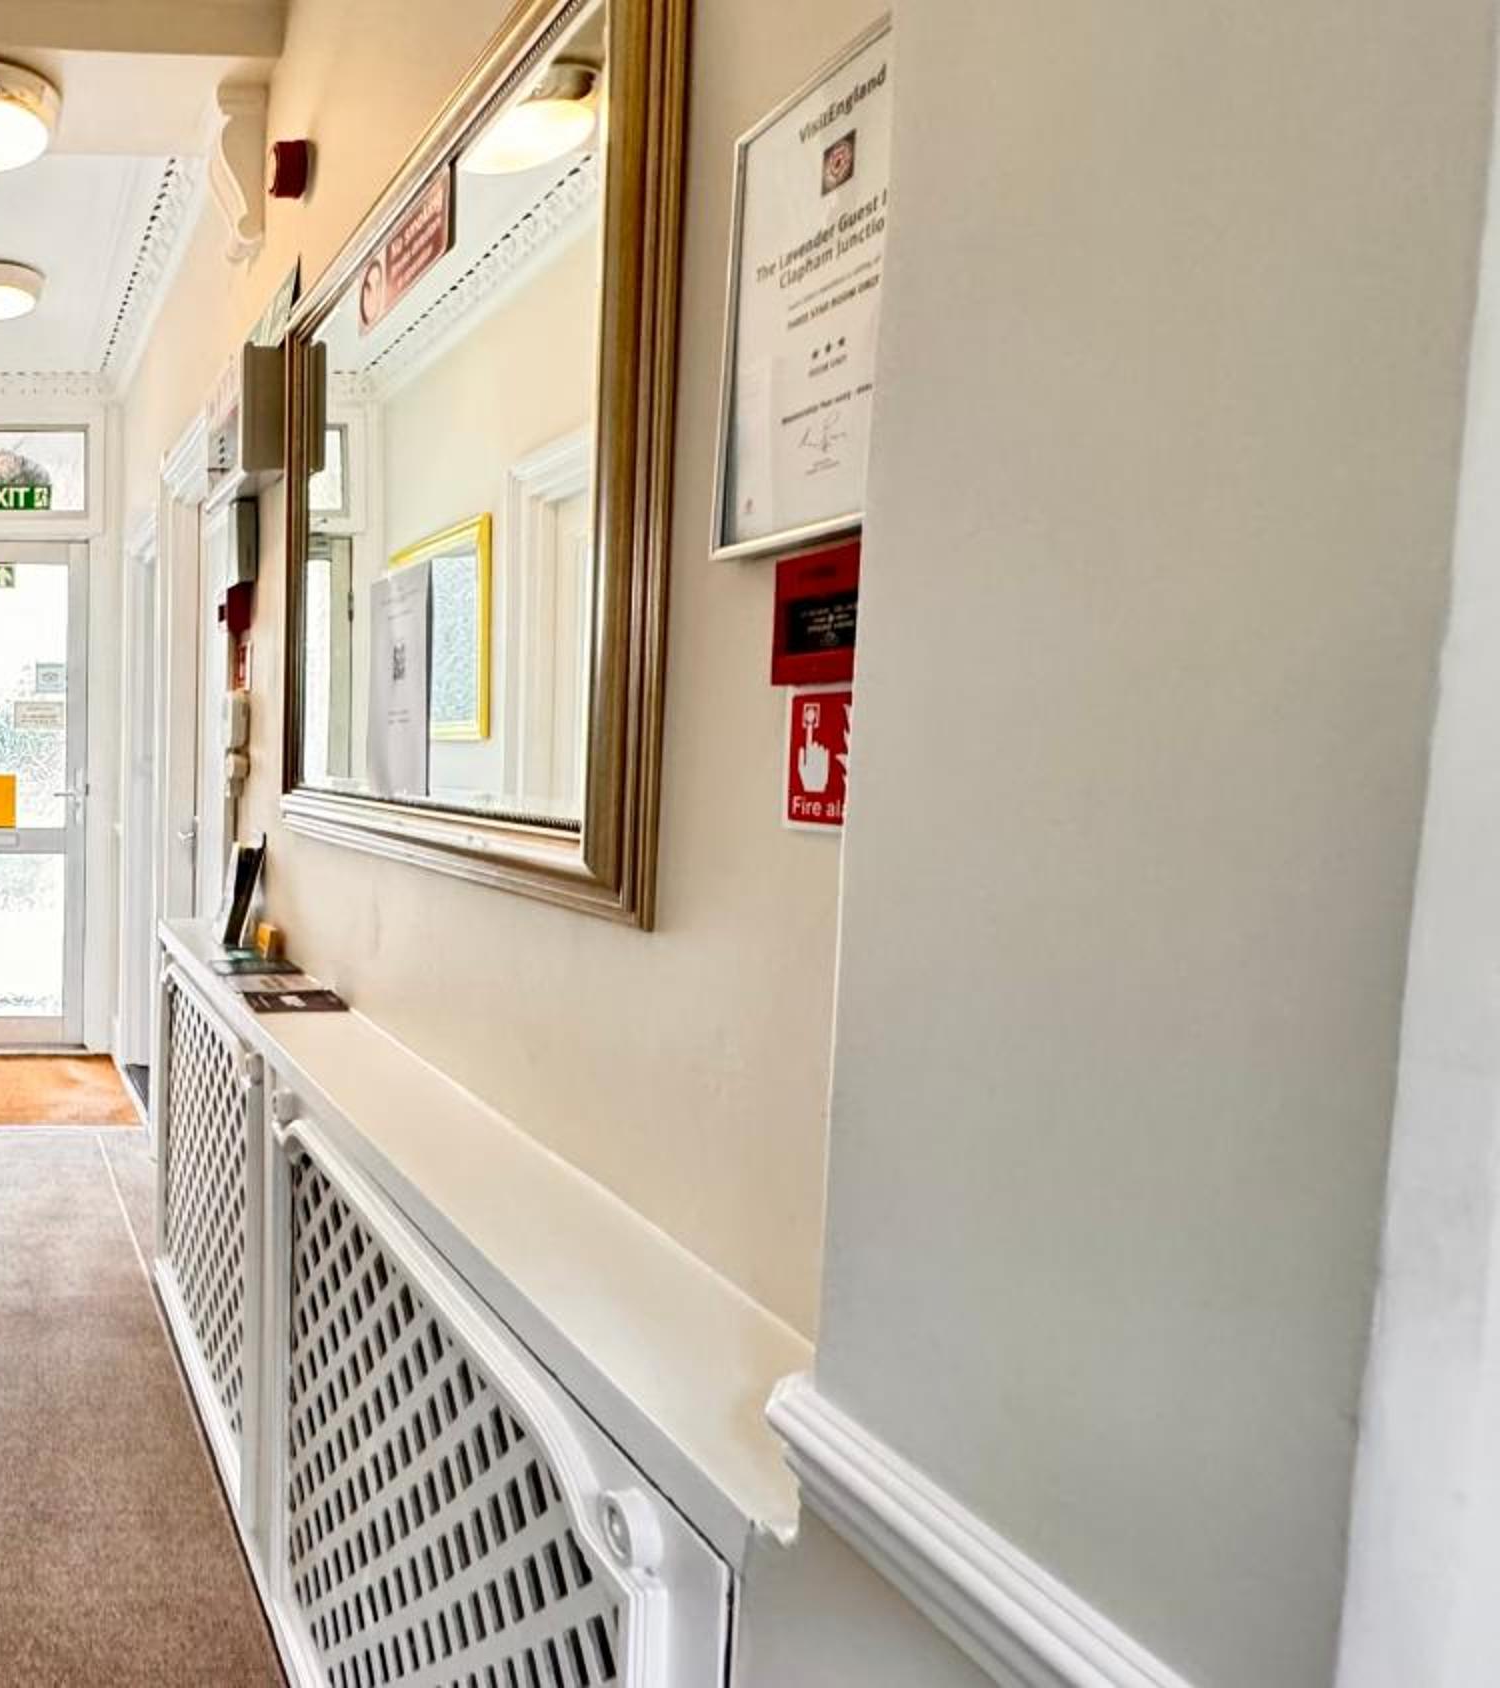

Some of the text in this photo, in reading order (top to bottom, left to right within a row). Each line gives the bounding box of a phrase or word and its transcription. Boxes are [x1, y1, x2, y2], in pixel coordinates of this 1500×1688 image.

[799, 63, 887, 144] VisitEngland
[756, 261, 776, 283] The
[779, 223, 835, 270] Lavender
[837, 195, 878, 233] Guest
[779, 247, 833, 289] Clapham
[836, 216, 885, 257] Junctio
[791, 795, 845, 817] Fire al
